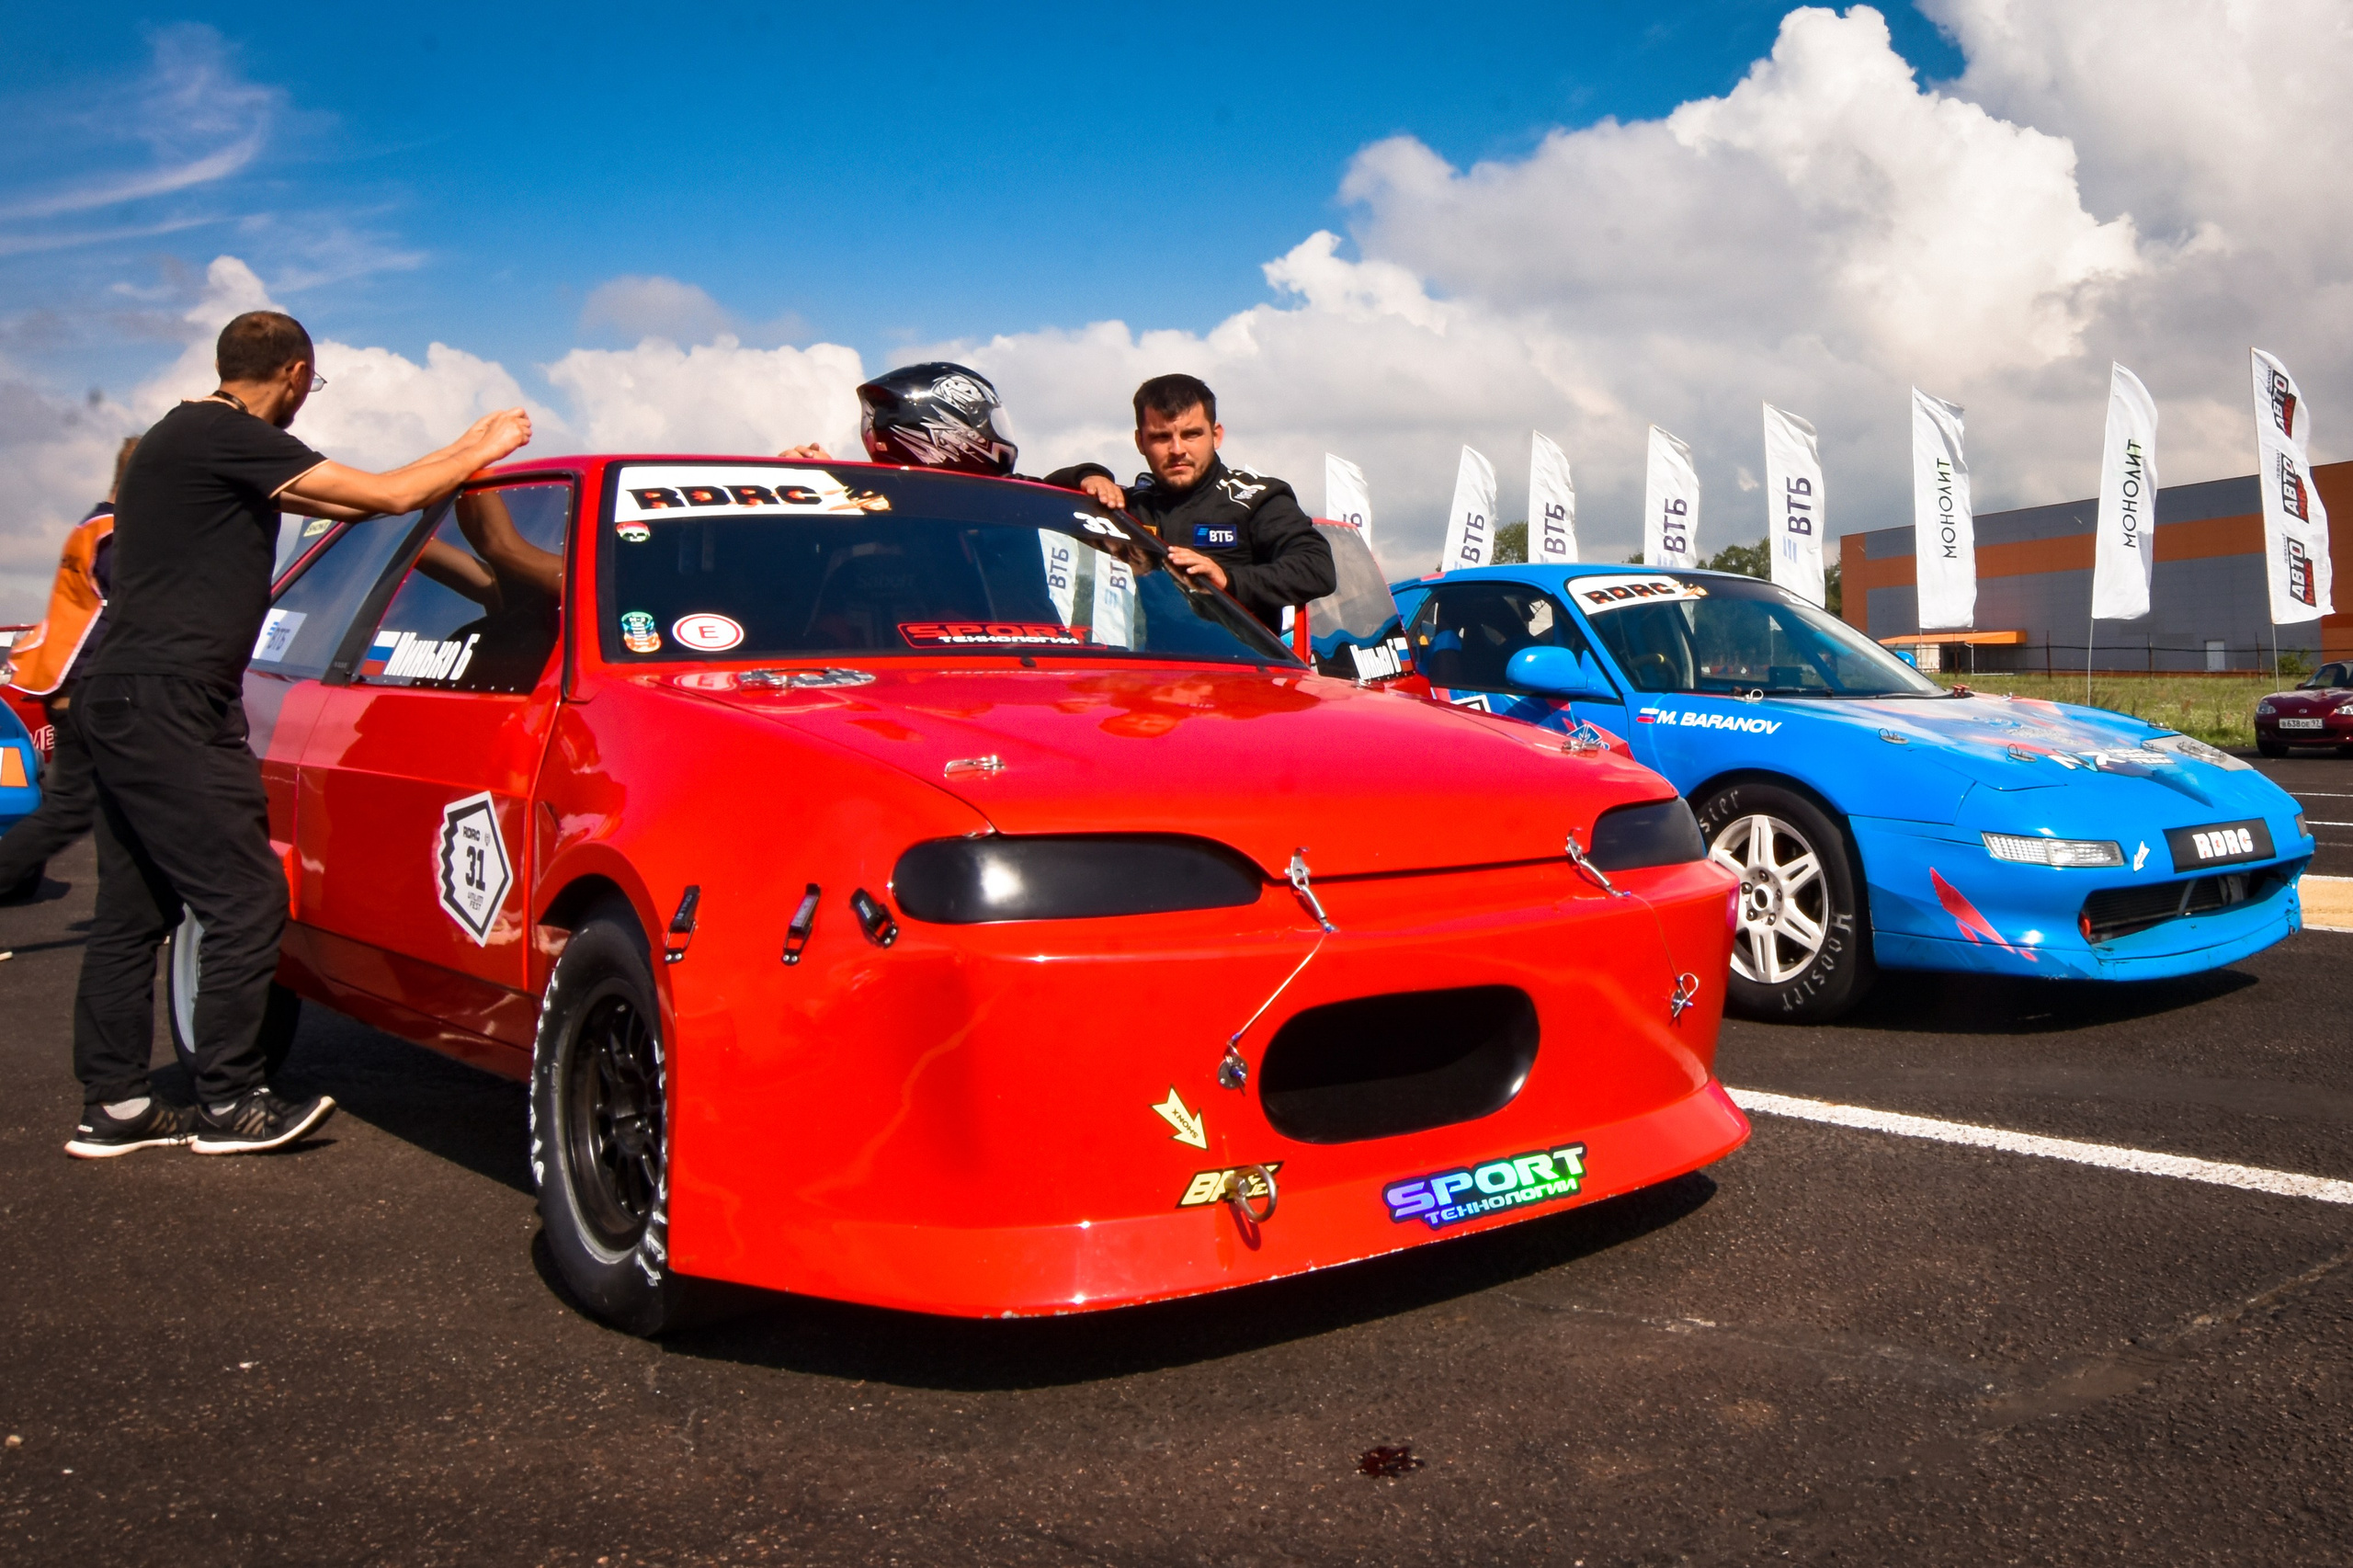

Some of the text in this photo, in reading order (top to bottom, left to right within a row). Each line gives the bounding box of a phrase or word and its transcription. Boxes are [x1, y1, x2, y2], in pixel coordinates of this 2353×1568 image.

[2272, 373, 2289, 434] АВТО
[626, 485, 824, 510] RDRC
[1786, 476, 1812, 536] ВТБ
[1937, 458, 1957, 559] МОНОЛИТ
[2122, 438, 2142, 548] МОНОЛИТ
[2282, 456, 2299, 516] АВТО
[1073, 511, 1131, 540] 31
[1209, 529, 1234, 542] ВТБ
[1461, 512, 1484, 563] ВТБ
[1544, 502, 1566, 555] ВТБ
[1664, 498, 1688, 553] ВТБ
[1048, 547, 1069, 589] ВТБ
[2289, 540, 2305, 602] АВТО
[1583, 582, 1677, 605] RDRC
[699, 626, 719, 639] E
[905, 625, 1088, 640] SPORT
[383, 632, 481, 680] Минько Б
[1657, 710, 1783, 735] M. BARANOV
[463, 825, 480, 842] RDRC
[2192, 828, 2254, 859] RDRC
[465, 846, 485, 892] 31
[470, 902, 481, 911] FEST
[1387, 1146, 1584, 1218] SPORT
